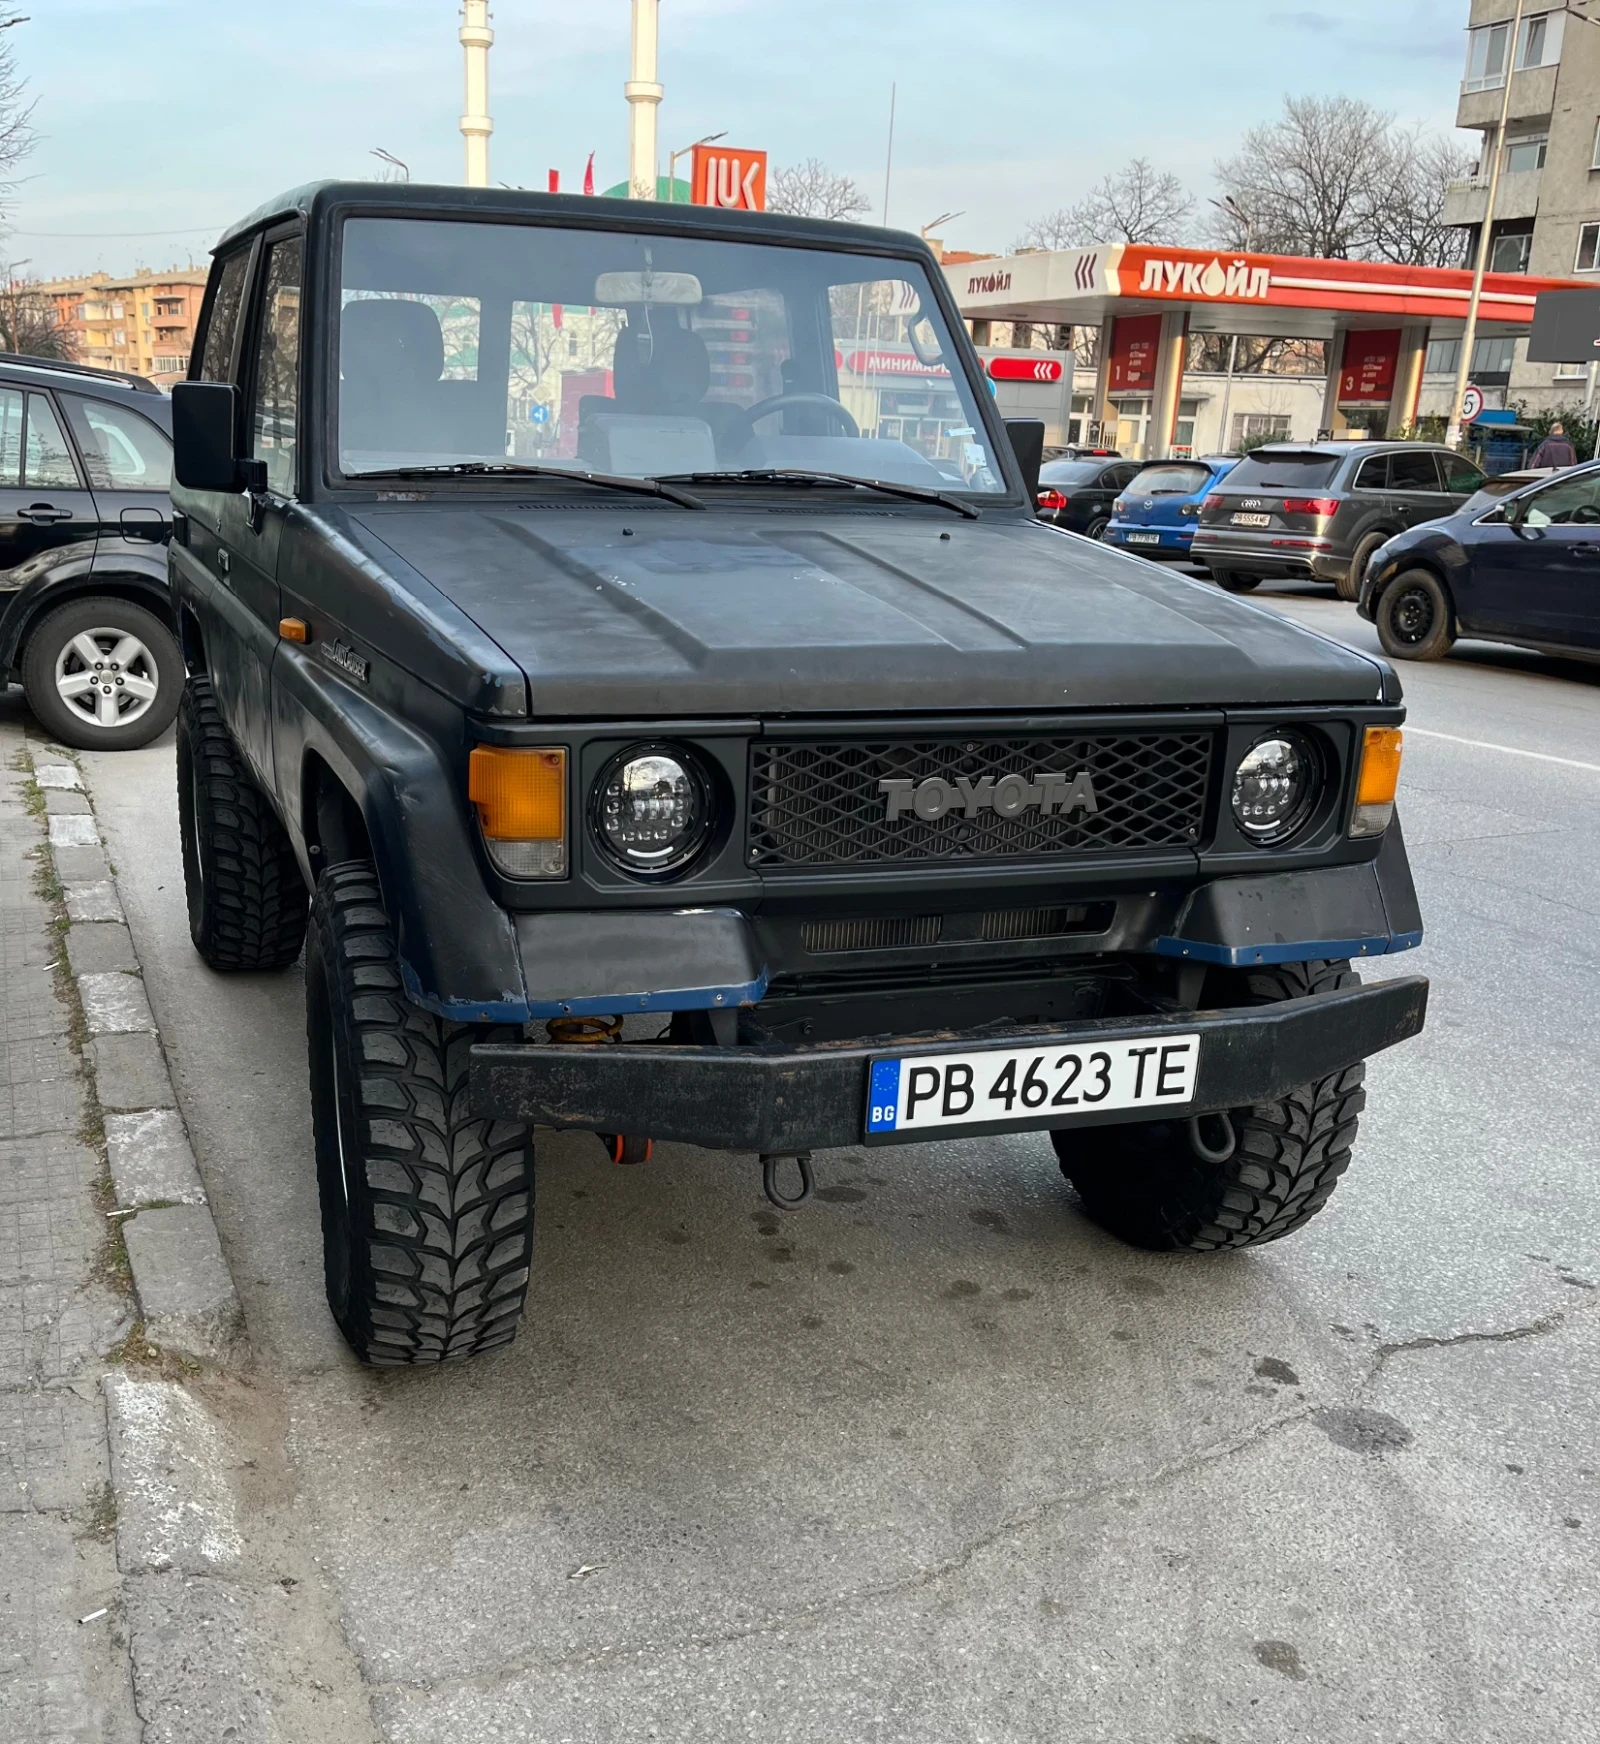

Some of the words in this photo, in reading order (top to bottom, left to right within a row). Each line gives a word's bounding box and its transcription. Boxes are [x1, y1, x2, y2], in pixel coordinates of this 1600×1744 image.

[1345, 376, 1354, 391] 3
[879, 771, 1098, 822] TOYOTA
[906, 1063, 974, 1120] PB
[988, 1052, 1112, 1111] 4623
[1128, 1044, 1190, 1098] TE
[872, 1106, 895, 1122] BG
